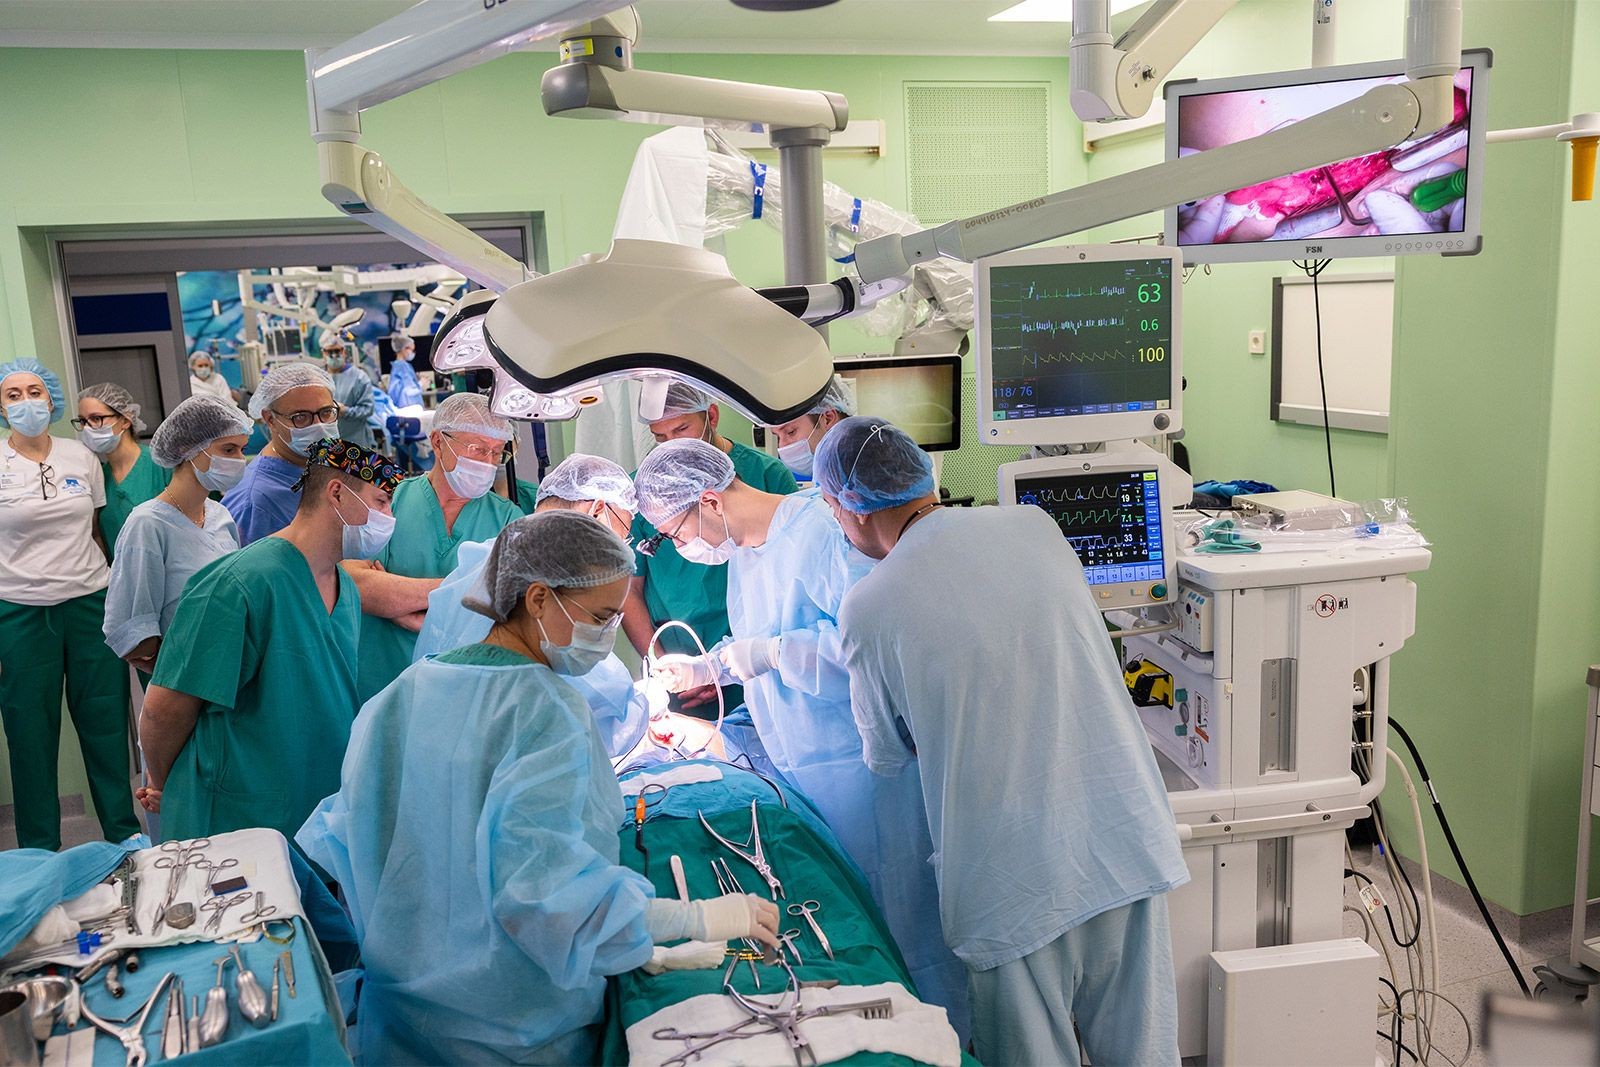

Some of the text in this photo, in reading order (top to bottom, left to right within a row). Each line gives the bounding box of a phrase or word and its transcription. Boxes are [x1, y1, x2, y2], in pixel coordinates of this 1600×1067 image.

[1305, 246, 1322, 254] FSN
[1137, 283, 1161, 303] 63
[1140, 318, 1159, 332] 0.6
[1138, 346, 1165, 363] 100
[1020, 386, 1033, 397] 76
[1121, 493, 1130, 503] 19
[1121, 514, 1132, 523] 7.1
[1124, 534, 1133, 542] 33
